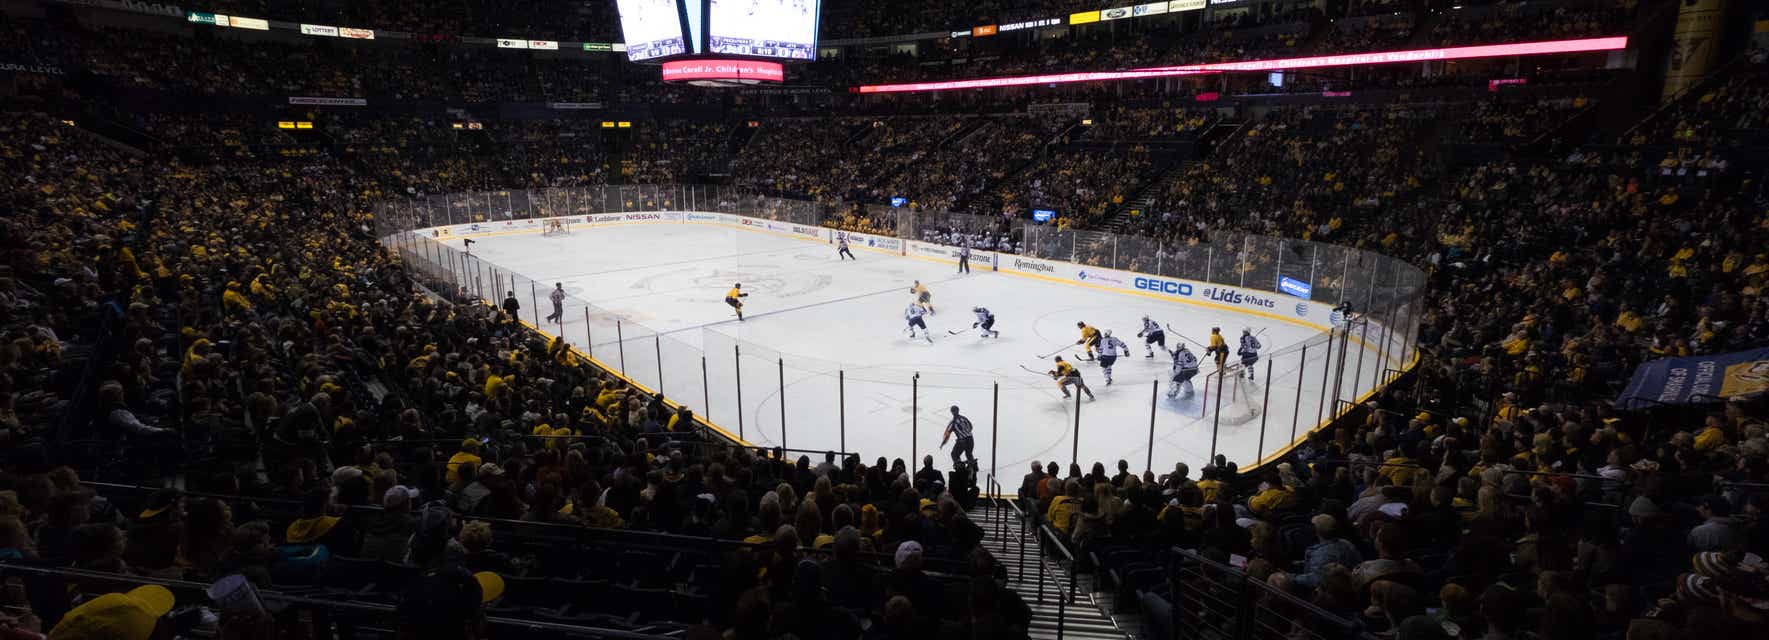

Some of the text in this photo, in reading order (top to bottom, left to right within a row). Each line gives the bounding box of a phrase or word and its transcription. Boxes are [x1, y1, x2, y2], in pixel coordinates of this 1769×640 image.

[999, 22, 1025, 32] NISSAN
[1327, 54, 1370, 65] Hospital
[625, 213, 661, 221] NISSAN
[1014, 258, 1056, 273] Remington
[1135, 277, 1192, 296] GEICO
[1203, 287, 1275, 308] @Lids 4hats
[1107, 340, 1114, 349] 5
